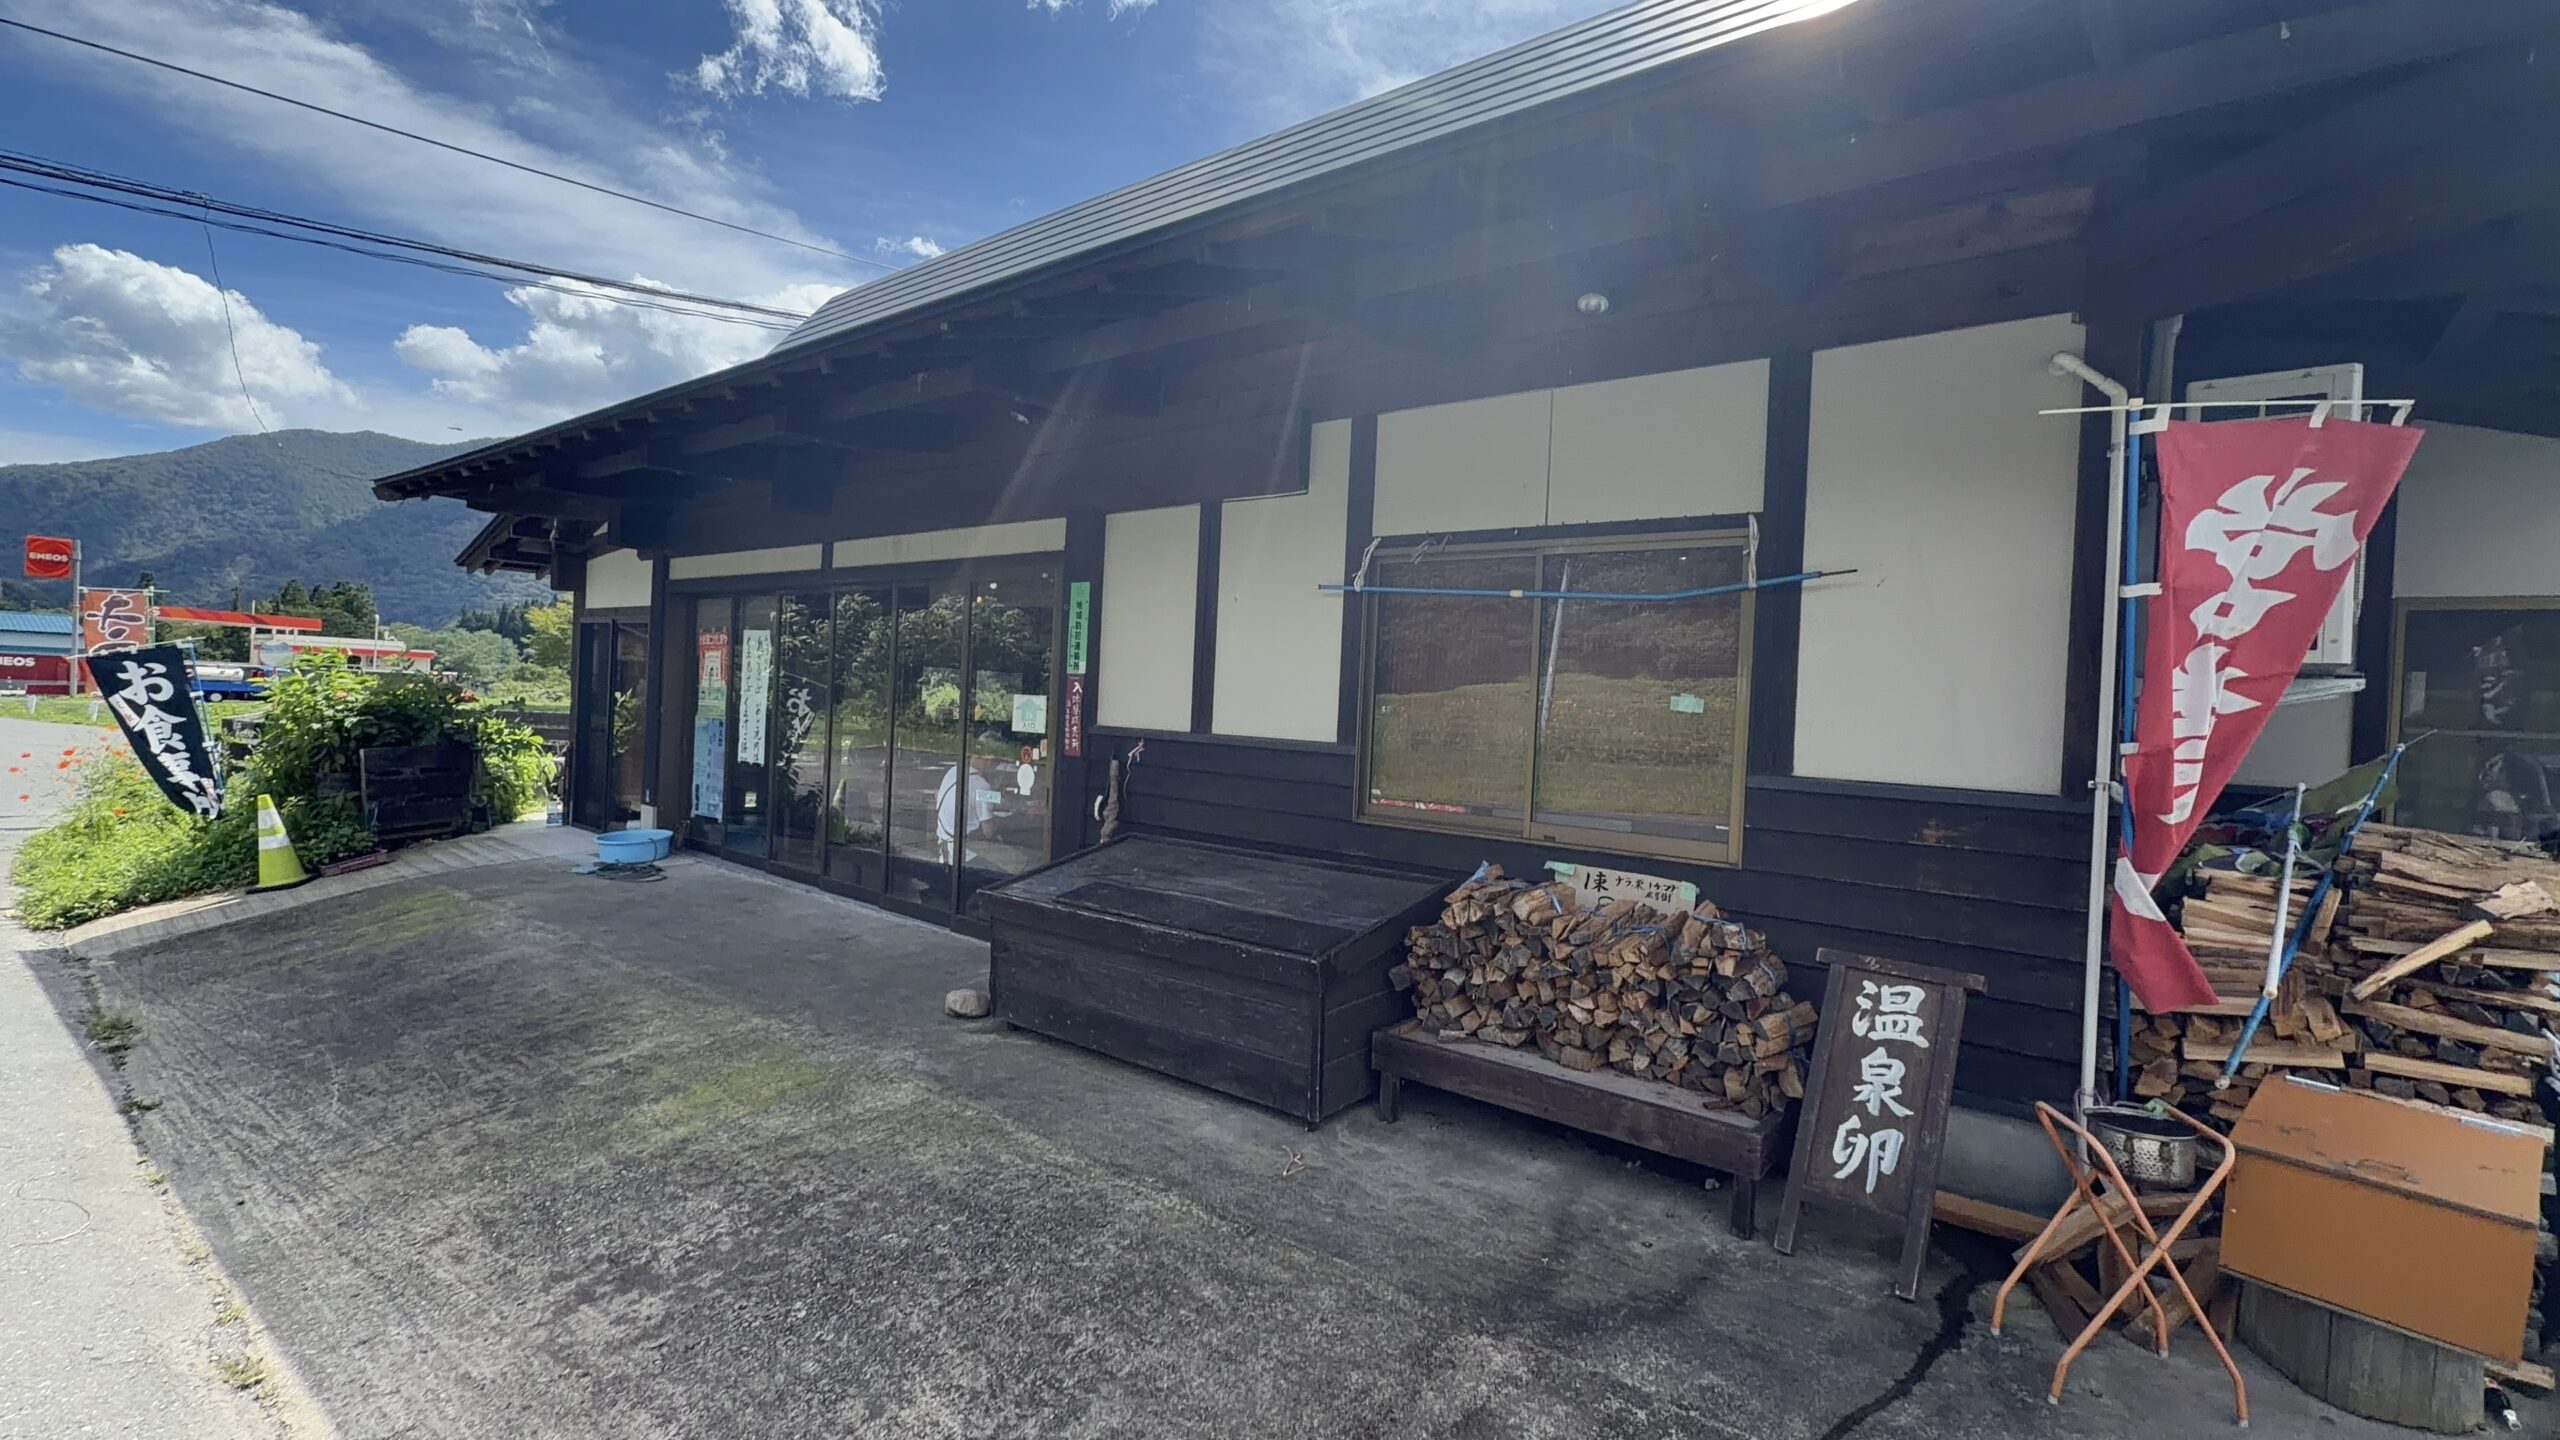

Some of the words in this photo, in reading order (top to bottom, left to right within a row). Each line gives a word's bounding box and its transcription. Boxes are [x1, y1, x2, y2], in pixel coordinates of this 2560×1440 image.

[28, 551, 69, 562] ENEOS
[0, 656, 36, 667] EOS
[1833, 980, 1929, 1194] 温泉卵
